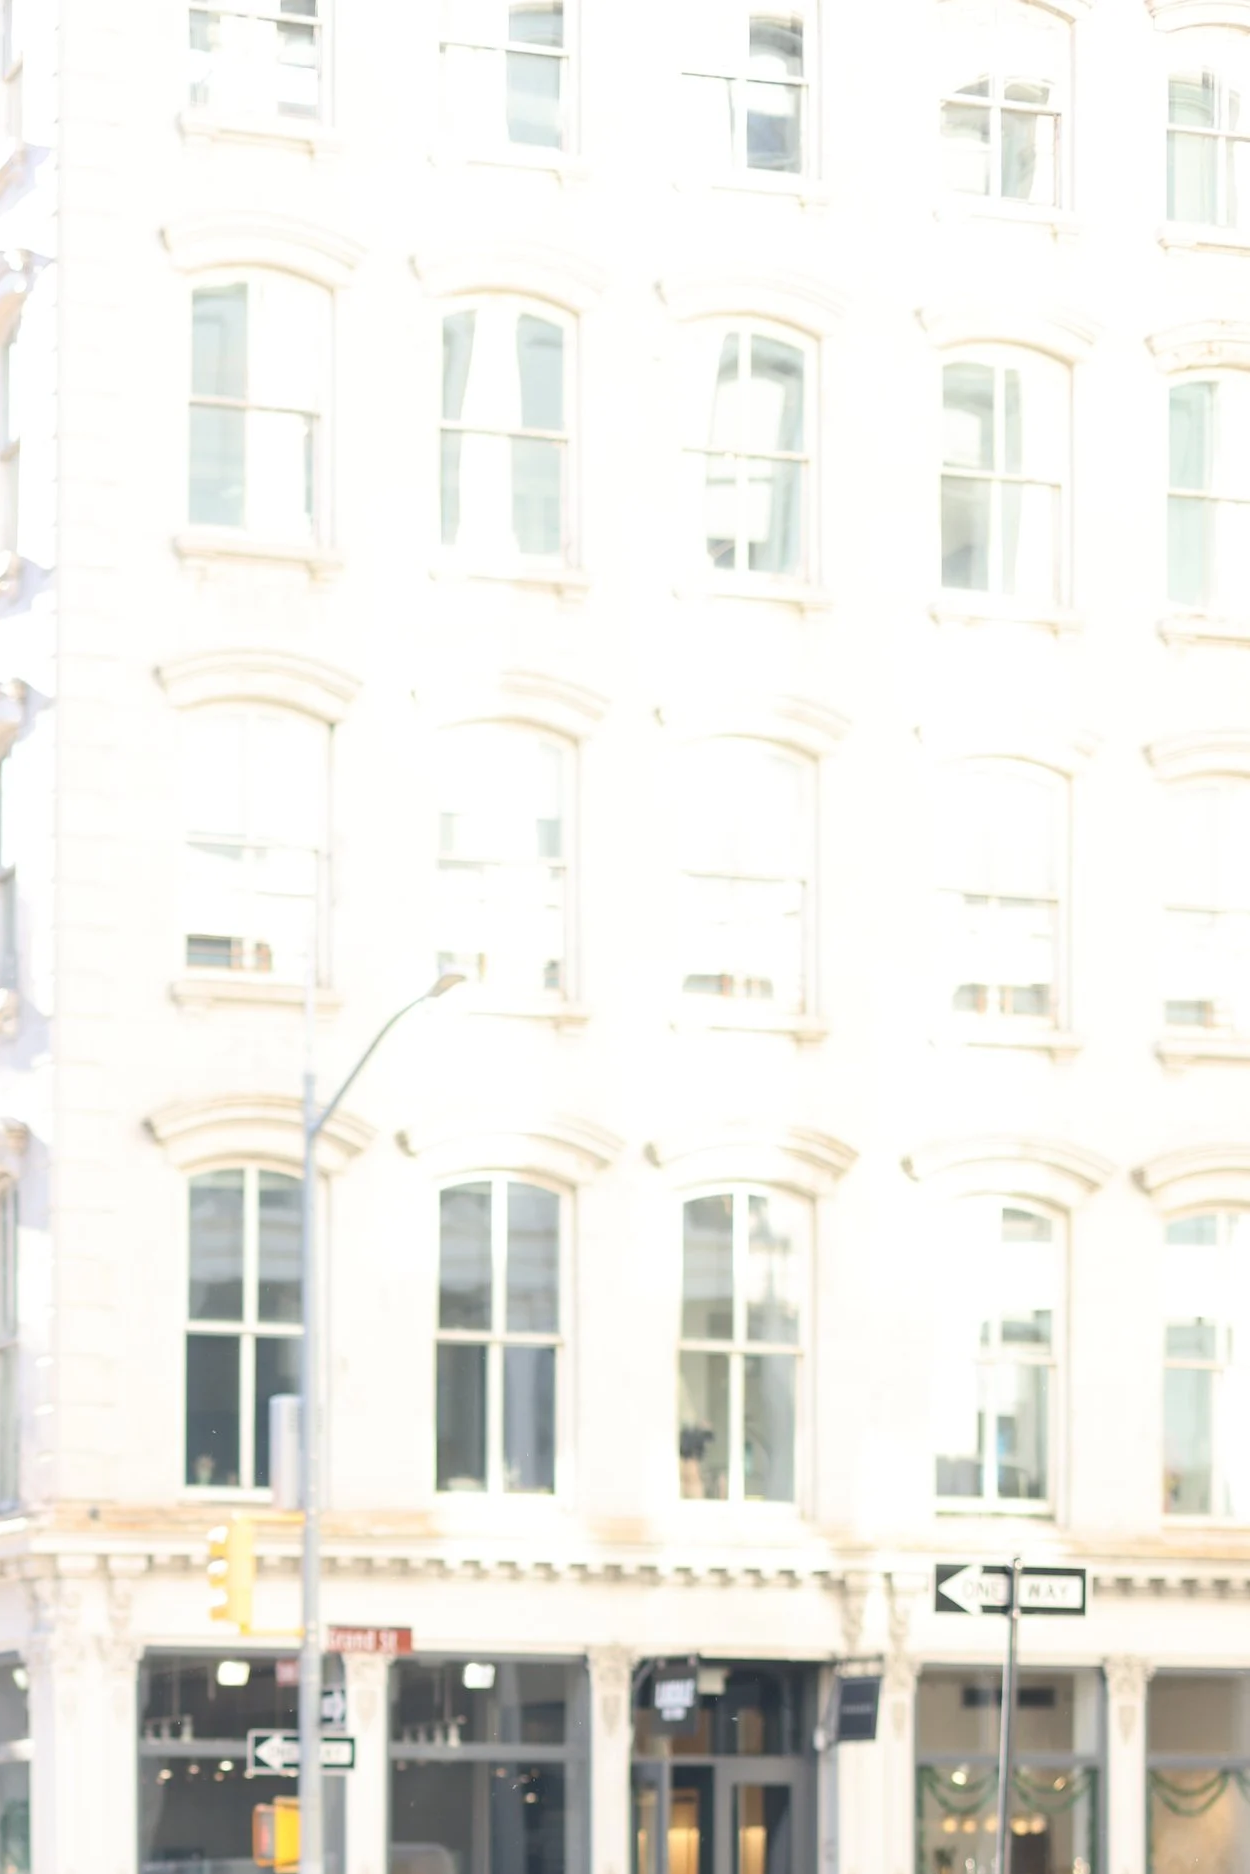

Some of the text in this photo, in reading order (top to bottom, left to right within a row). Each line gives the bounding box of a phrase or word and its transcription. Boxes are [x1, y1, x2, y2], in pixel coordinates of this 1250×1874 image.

[961, 1578, 1069, 1600] ONE WAY
[328, 1629, 398, 1652] Grand St
